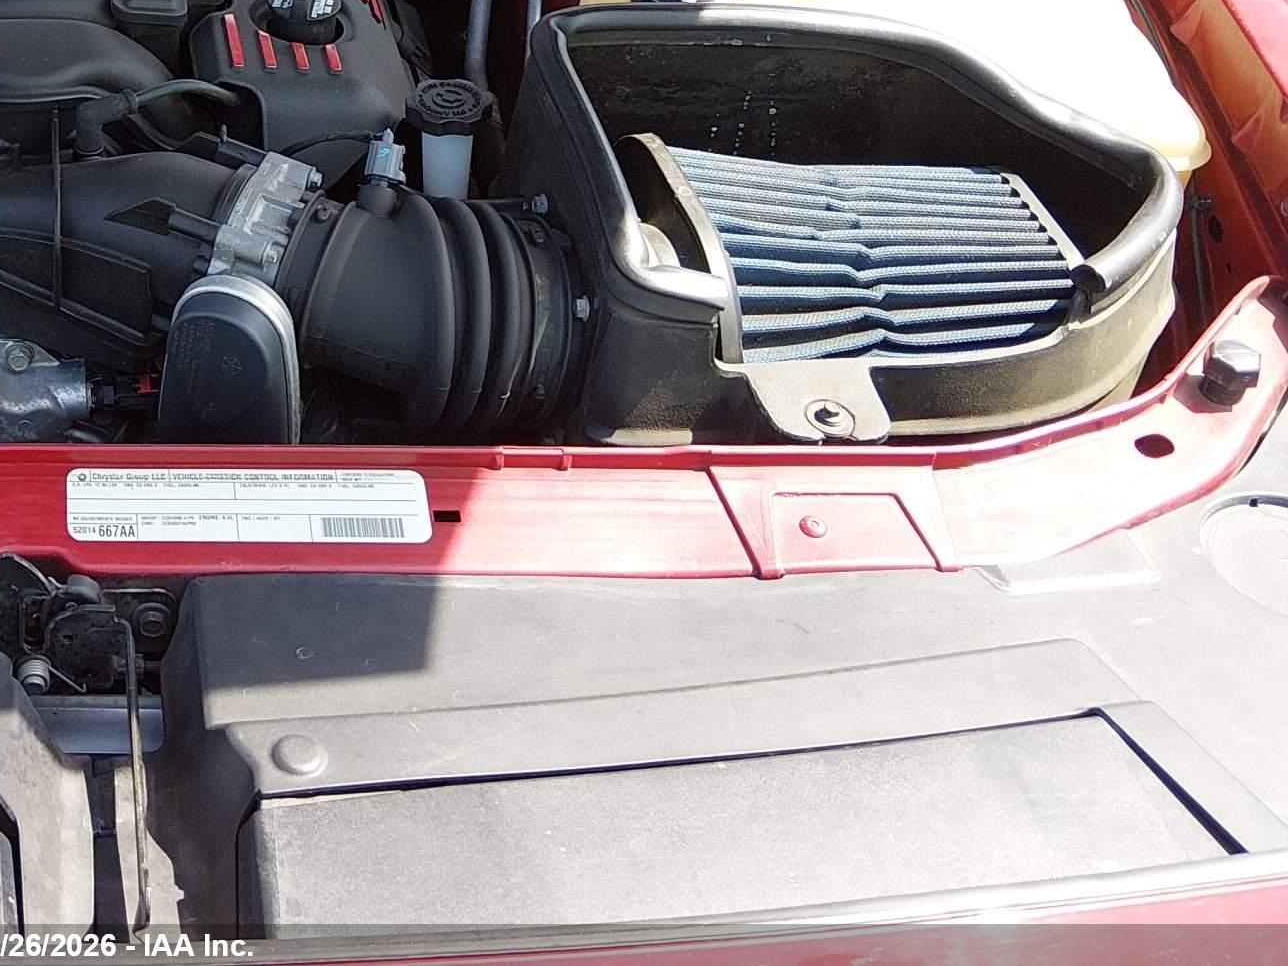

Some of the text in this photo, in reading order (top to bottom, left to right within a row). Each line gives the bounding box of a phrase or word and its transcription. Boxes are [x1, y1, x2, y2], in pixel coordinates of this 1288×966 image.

[92, 473, 123, 481] Chrysler
[126, 473, 149, 481] Group
[173, 473, 204, 481] VEHICLE
[244, 473, 279, 481] CONTROL
[282, 473, 334, 481] INFORMATION
[72, 524, 136, 538] 52014 667AA
